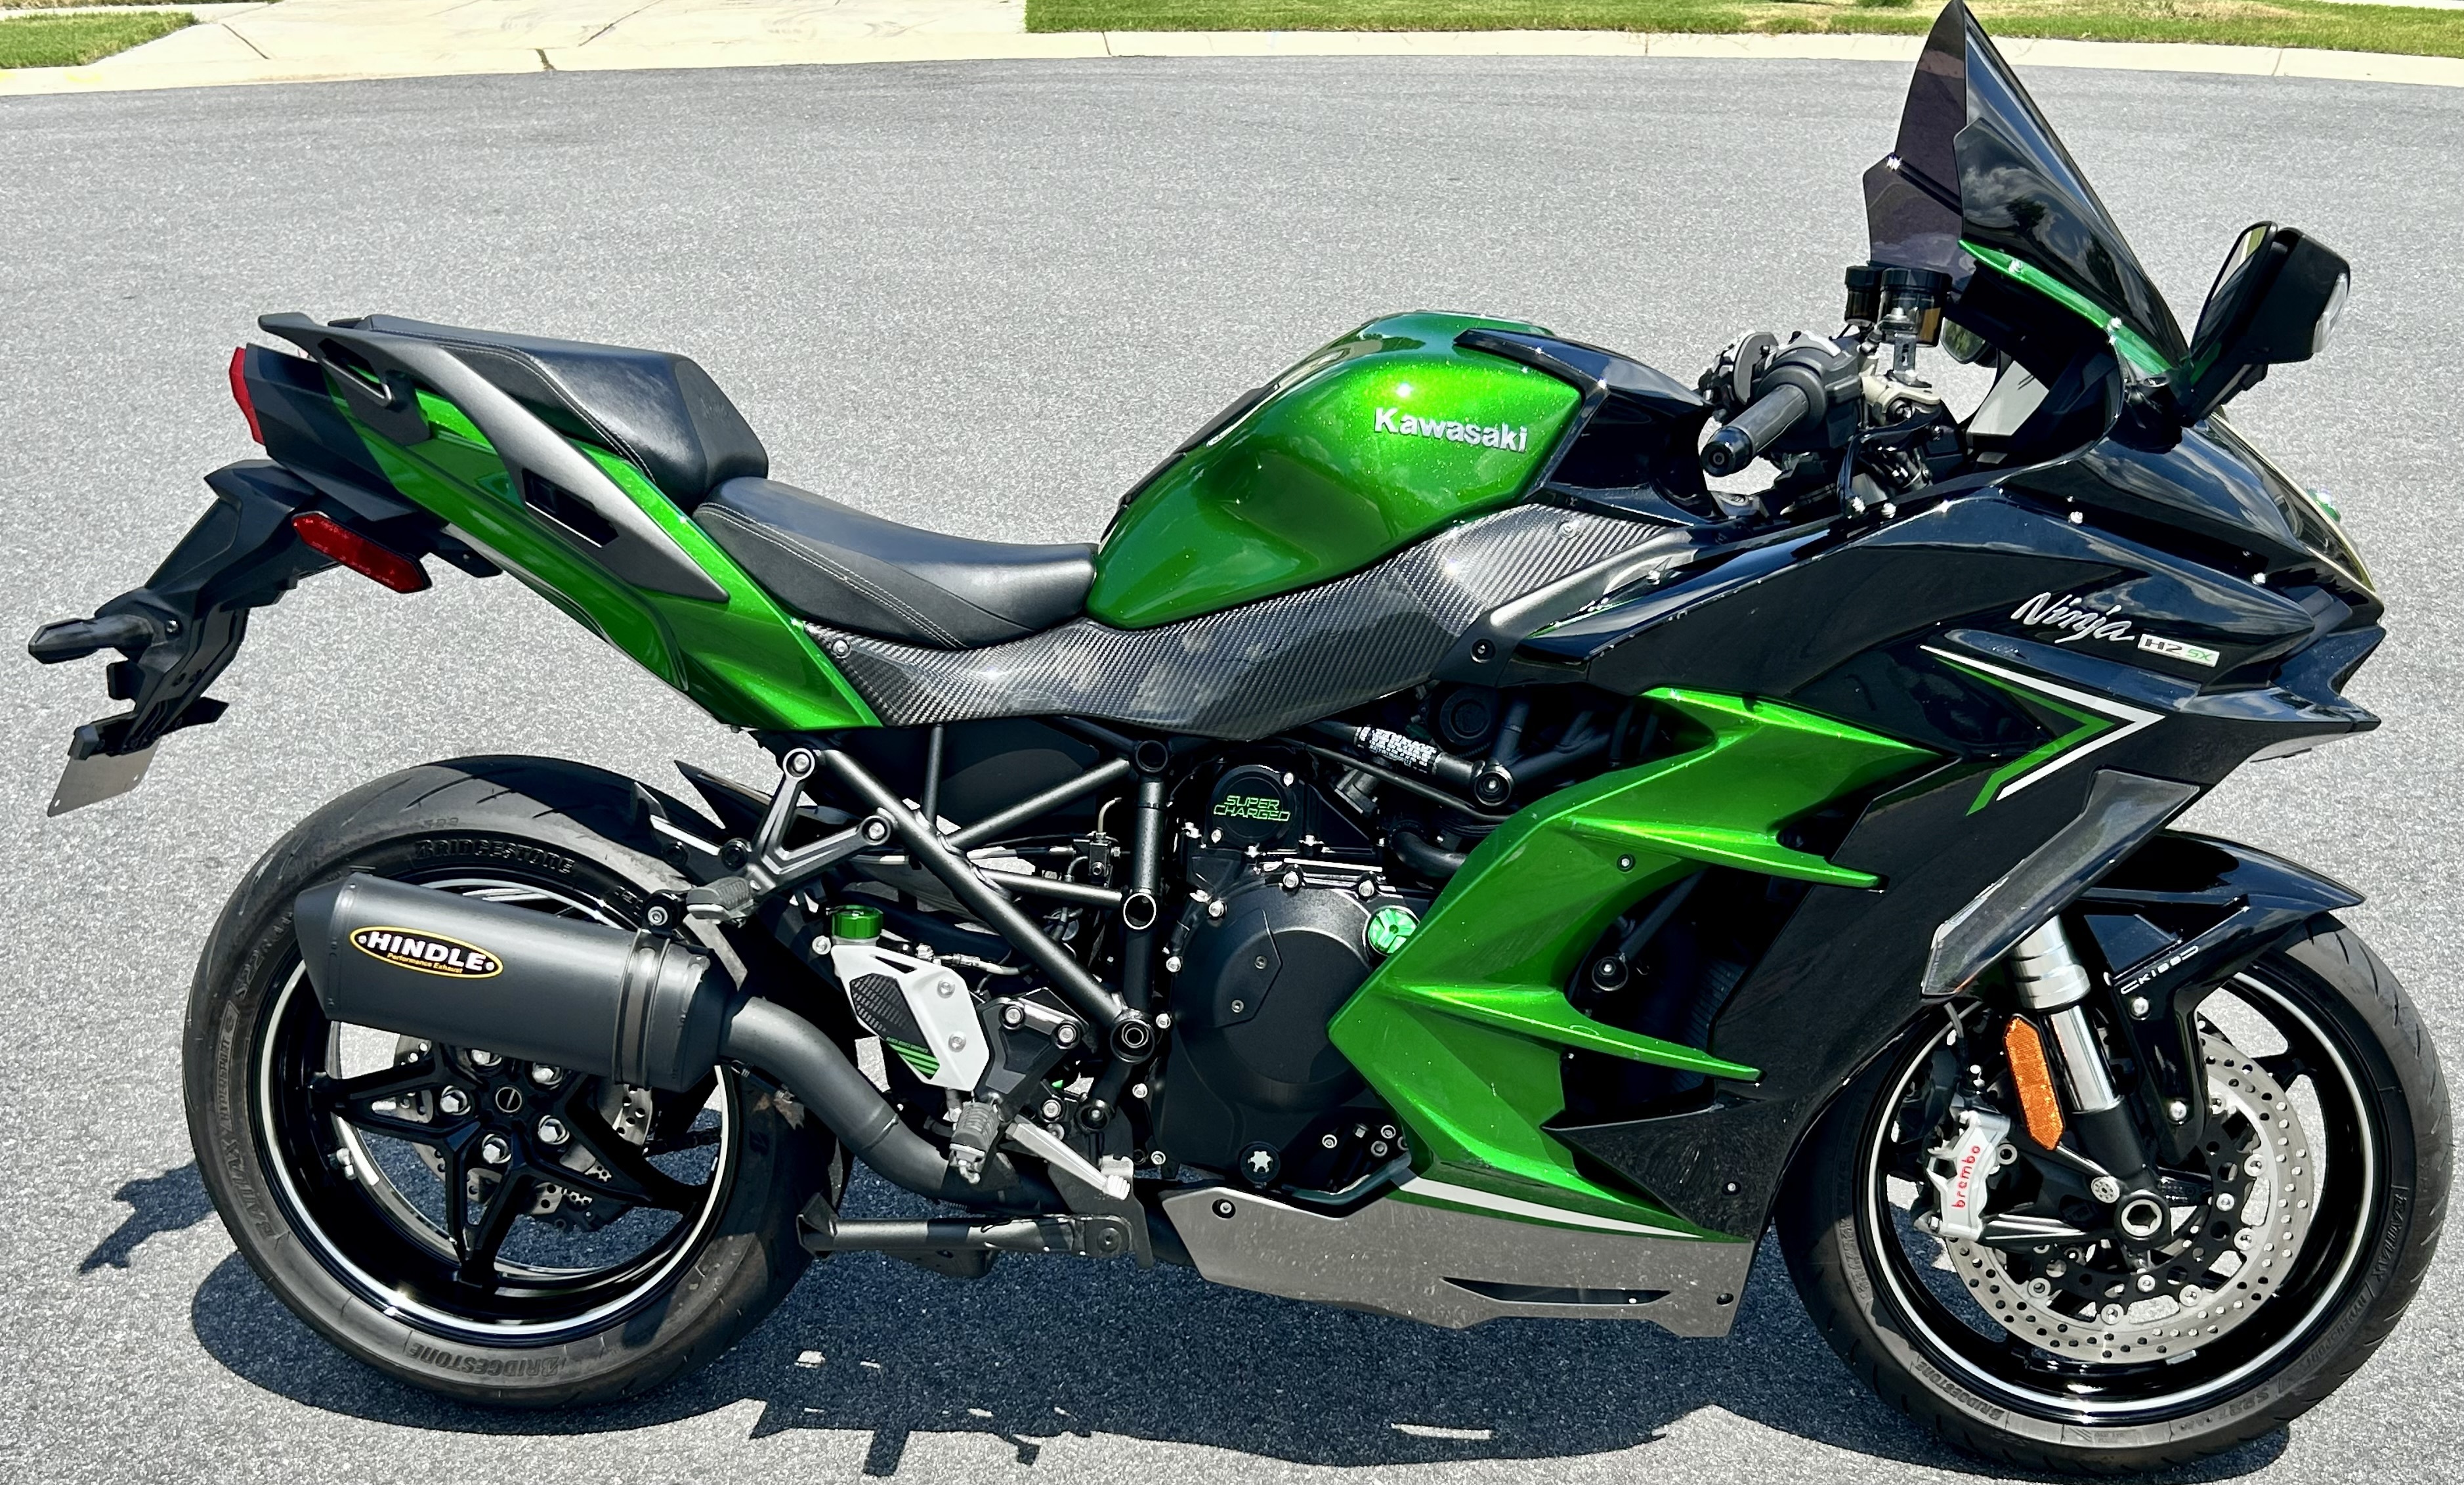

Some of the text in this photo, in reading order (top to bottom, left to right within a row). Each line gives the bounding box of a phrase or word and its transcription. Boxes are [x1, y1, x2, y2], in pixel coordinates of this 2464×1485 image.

[1374, 407, 1528, 453] Kawasaki
[2010, 592, 2213, 662] Ninja H2 SX
[1214, 805, 1290, 821] CHARGED
[1224, 795, 1280, 810] SUPER
[415, 838, 575, 874] BRIDGESTONE
[367, 931, 486, 971] HINDLE
[387, 952, 463, 973] Performance Exhaust
[1951, 1146, 1981, 1209] brembo
[409, 1341, 560, 1377] BRIDGESTONE
[1915, 1361, 2005, 1421] BRIDGESTONE
